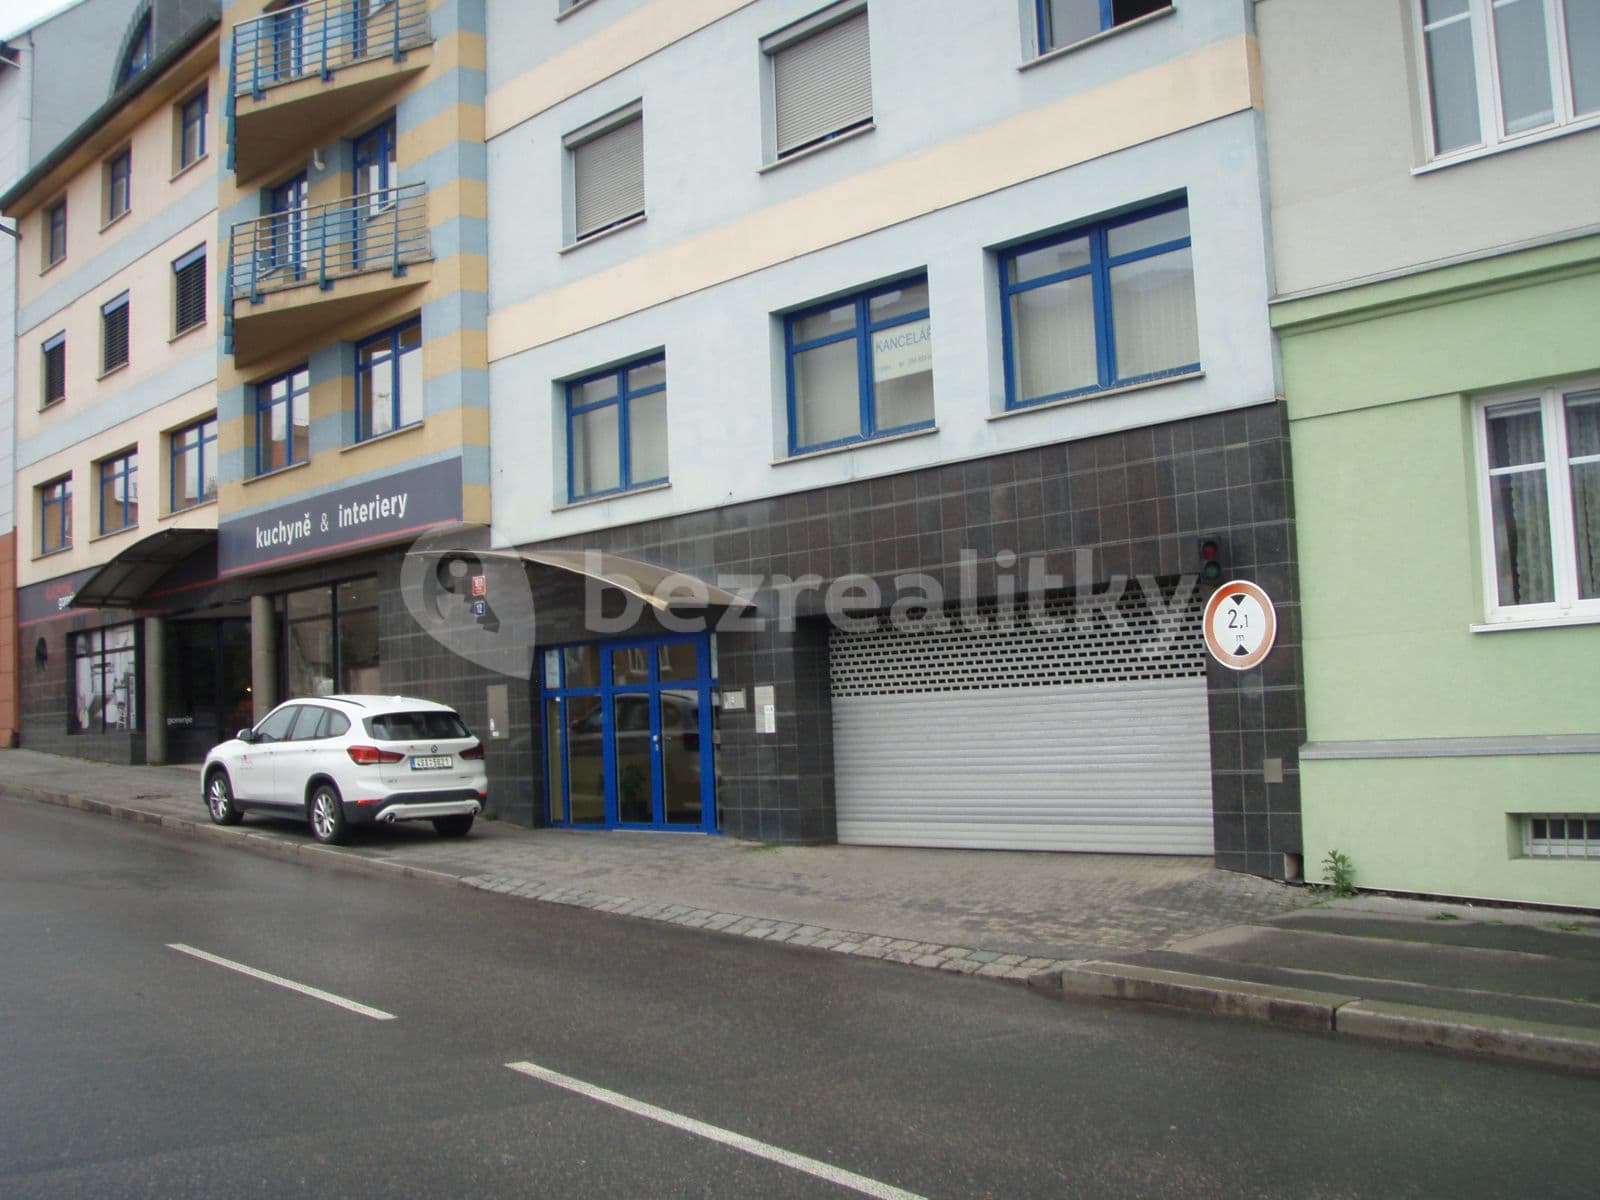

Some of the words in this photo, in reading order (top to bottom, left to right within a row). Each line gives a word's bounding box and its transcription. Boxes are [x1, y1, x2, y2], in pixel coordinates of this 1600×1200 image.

[256, 512, 311, 549] kuchyně
[320, 512, 329, 533] &
[338, 493, 408, 529] interiery
[1228, 609, 1249, 629] 2,1
[1236, 634, 1245, 642] m
